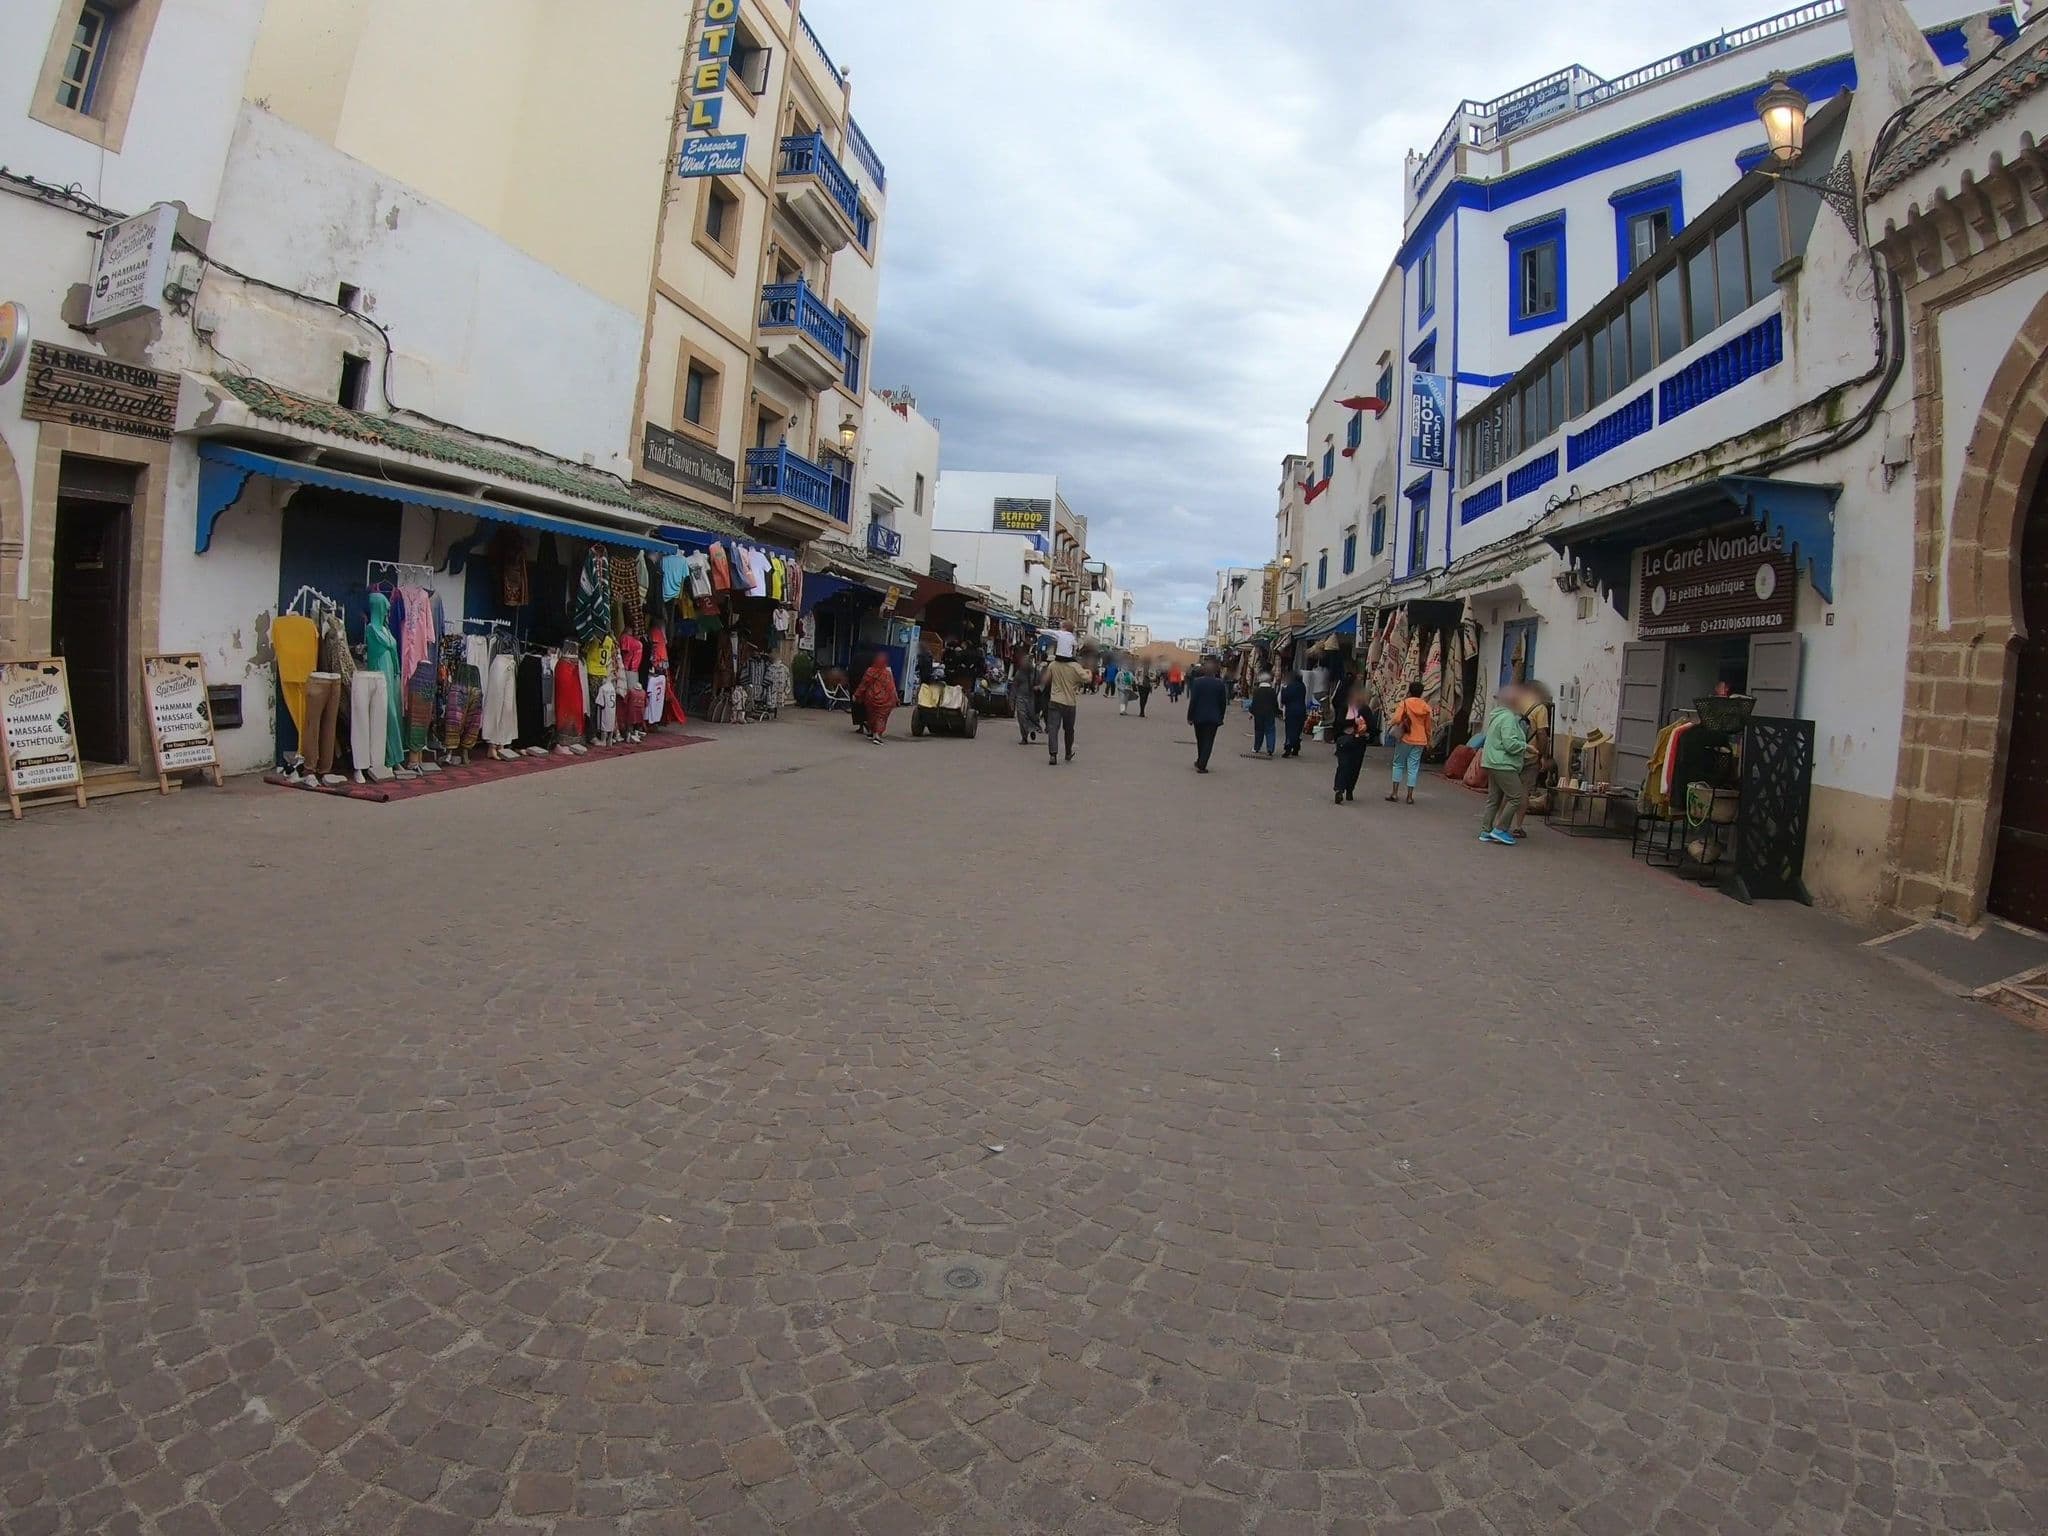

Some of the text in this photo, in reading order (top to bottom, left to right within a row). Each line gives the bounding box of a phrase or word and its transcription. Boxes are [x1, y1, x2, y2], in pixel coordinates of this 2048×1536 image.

[688, 139, 737, 154] Essaouira
[680, 152, 741, 172] Wind Palace
[111, 259, 148, 280] HAMMAM
[116, 272, 146, 288] MASSAGE
[67, 353, 158, 389] RELAXATION
[32, 367, 172, 421] Spirituelle
[70, 412, 171, 441] SPA & HAMMAM
[1421, 395, 1434, 460] HOTEL
[1001, 511, 1042, 522] SEAFOOD
[1006, 521, 1035, 529] CORNER
[1645, 555, 1660, 577] Le
[1664, 540, 1703, 573] Carré
[1669, 578, 1745, 603] la petite boutique
[600, 650, 607, 666] 9
[9, 684, 58, 708] Spirituelle
[155, 676, 197, 698] Spirituelle
[160, 702, 192, 711] HAMMAM
[609, 695, 615, 708] 5
[13, 713, 52, 724] HAMMAM
[161, 713, 193, 722] MASSAGE
[15, 725, 53, 736] MASSAGE
